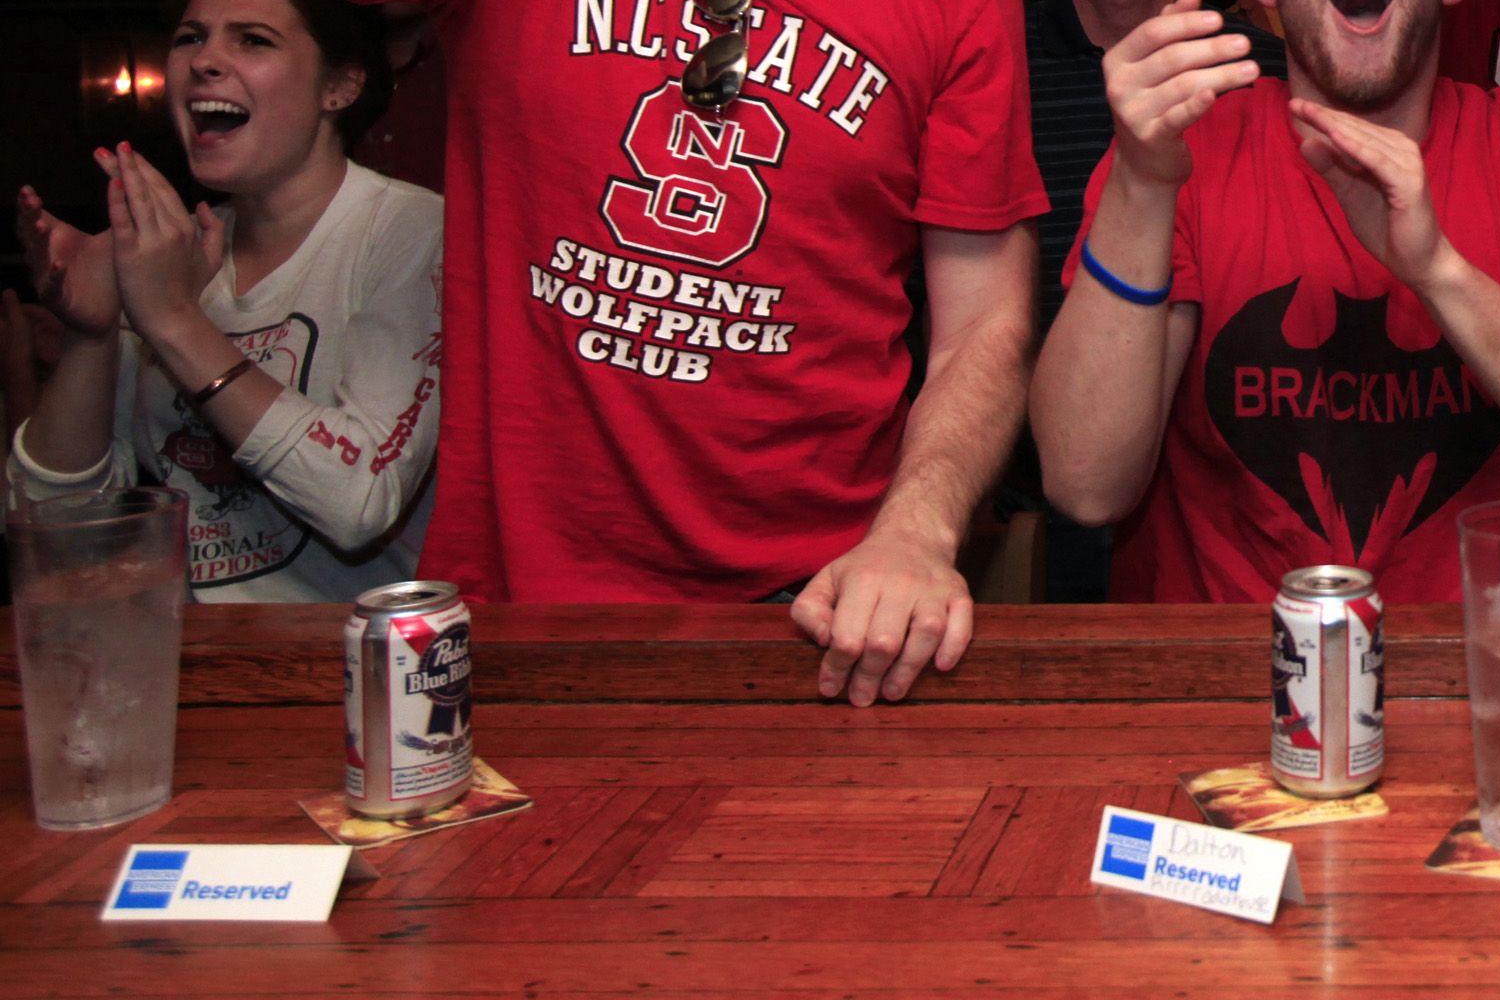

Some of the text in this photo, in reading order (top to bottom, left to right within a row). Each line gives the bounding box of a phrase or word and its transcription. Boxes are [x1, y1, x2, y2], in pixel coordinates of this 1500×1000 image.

[549, 236, 786, 319] STUDENT
[529, 263, 798, 355] WOLFPACK
[576, 328, 714, 384] CLUB
[408, 671, 448, 693] Blue
[180, 880, 293, 901] Reserved
[1155, 856, 1241, 892] Reserved
